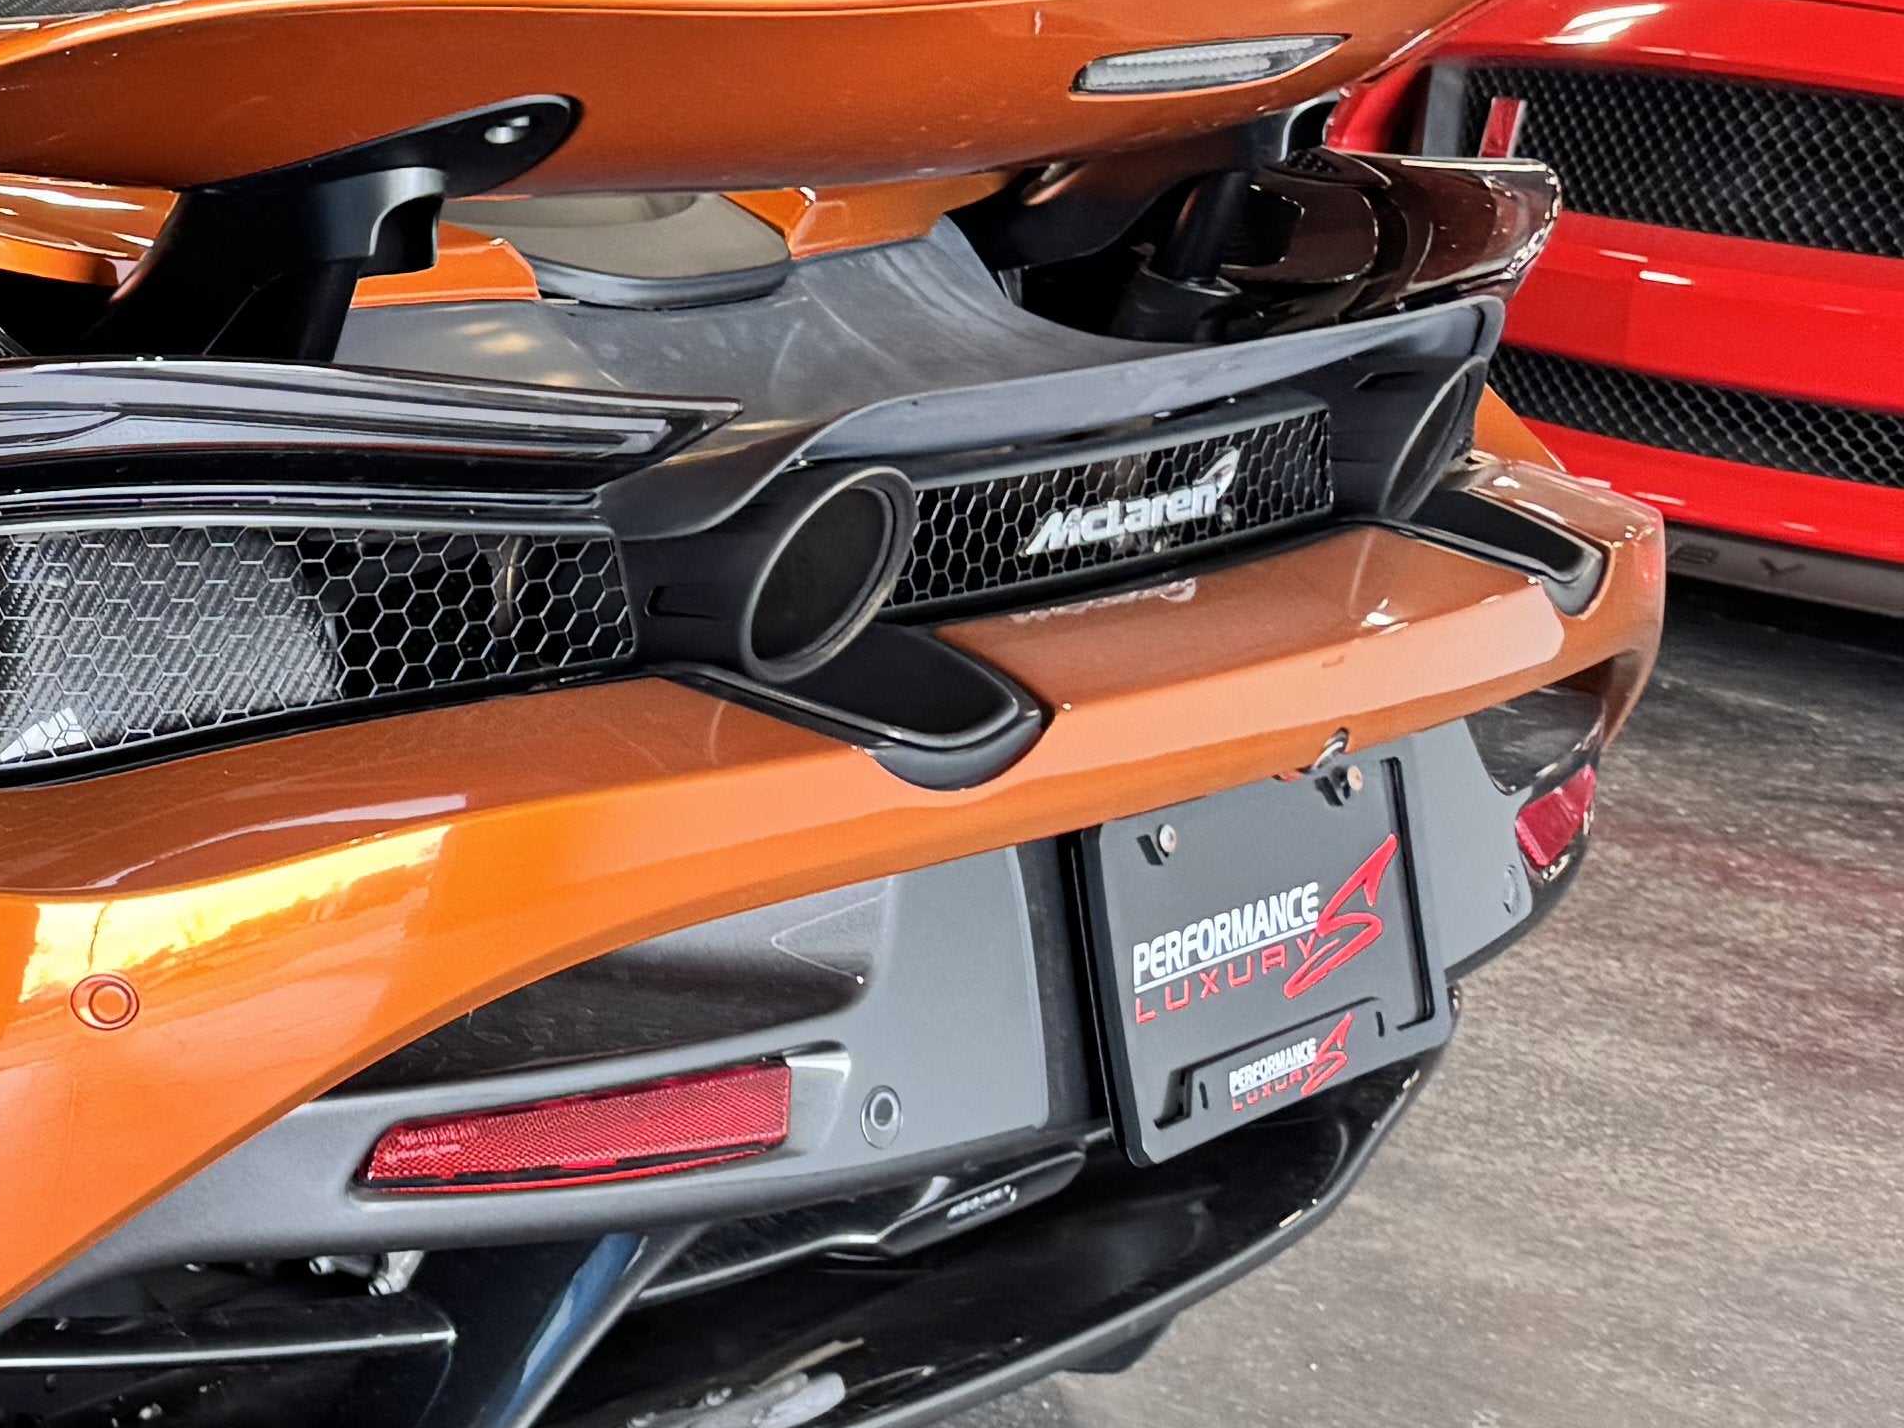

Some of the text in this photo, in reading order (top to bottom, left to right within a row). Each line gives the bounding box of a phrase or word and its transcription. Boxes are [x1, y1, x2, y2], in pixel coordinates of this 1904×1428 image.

[1022, 479, 1218, 556] McLaren
[1133, 881, 1320, 987] PERFORMANCE
[1135, 933, 1317, 1025] LUXURY
[1229, 1037, 1317, 1094] PERFORMANCE
